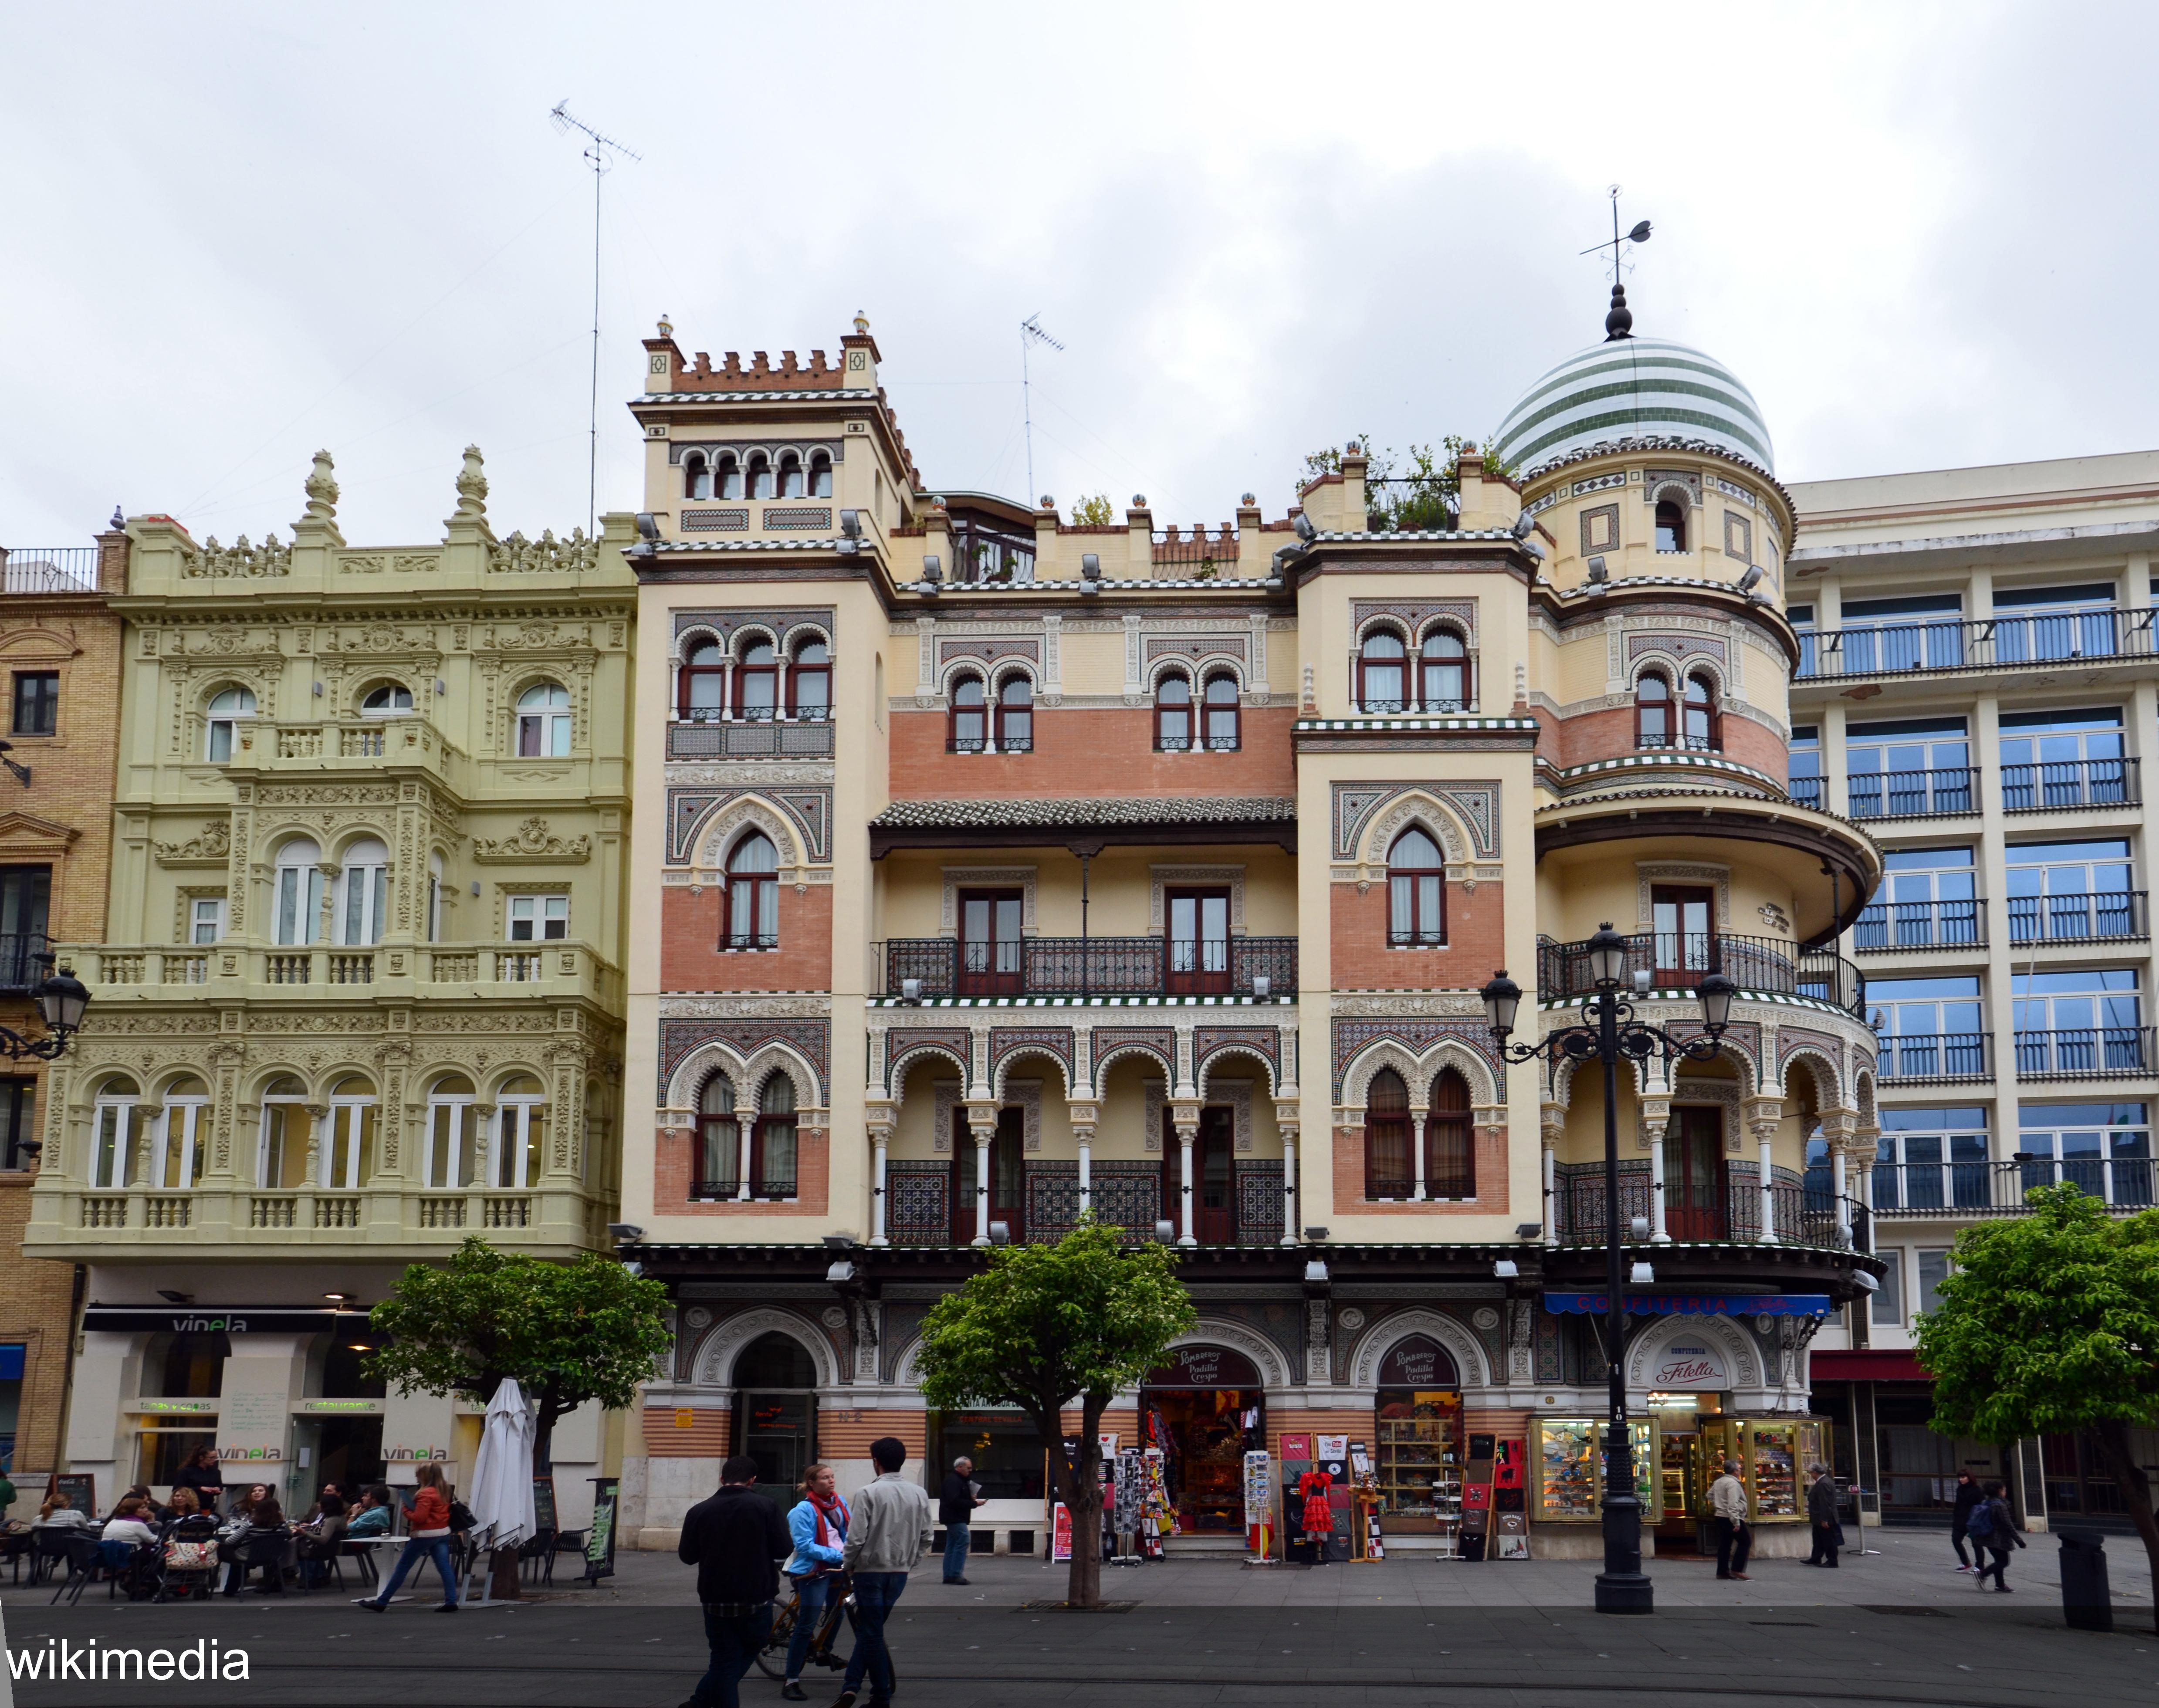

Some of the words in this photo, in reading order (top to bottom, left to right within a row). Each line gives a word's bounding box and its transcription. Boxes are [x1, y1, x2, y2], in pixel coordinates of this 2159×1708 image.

[173, 1315, 247, 1331] vinela
[1188, 1363, 1218, 1373] Padilla
[1404, 1364, 1434, 1374] Padilla
[1656, 1358, 1723, 1384] Filella
[1191, 1373, 1218, 1383] Crespo
[1407, 1373, 1434, 1383] Crespo
[140, 1401, 169, 1411] tapas
[180, 1403, 211, 1412] copas
[305, 1401, 376, 1411] restaurante
[854, 1411, 861, 1422] 2
[217, 1443, 281, 1459] vinela
[383, 1443, 447, 1460] vinela
